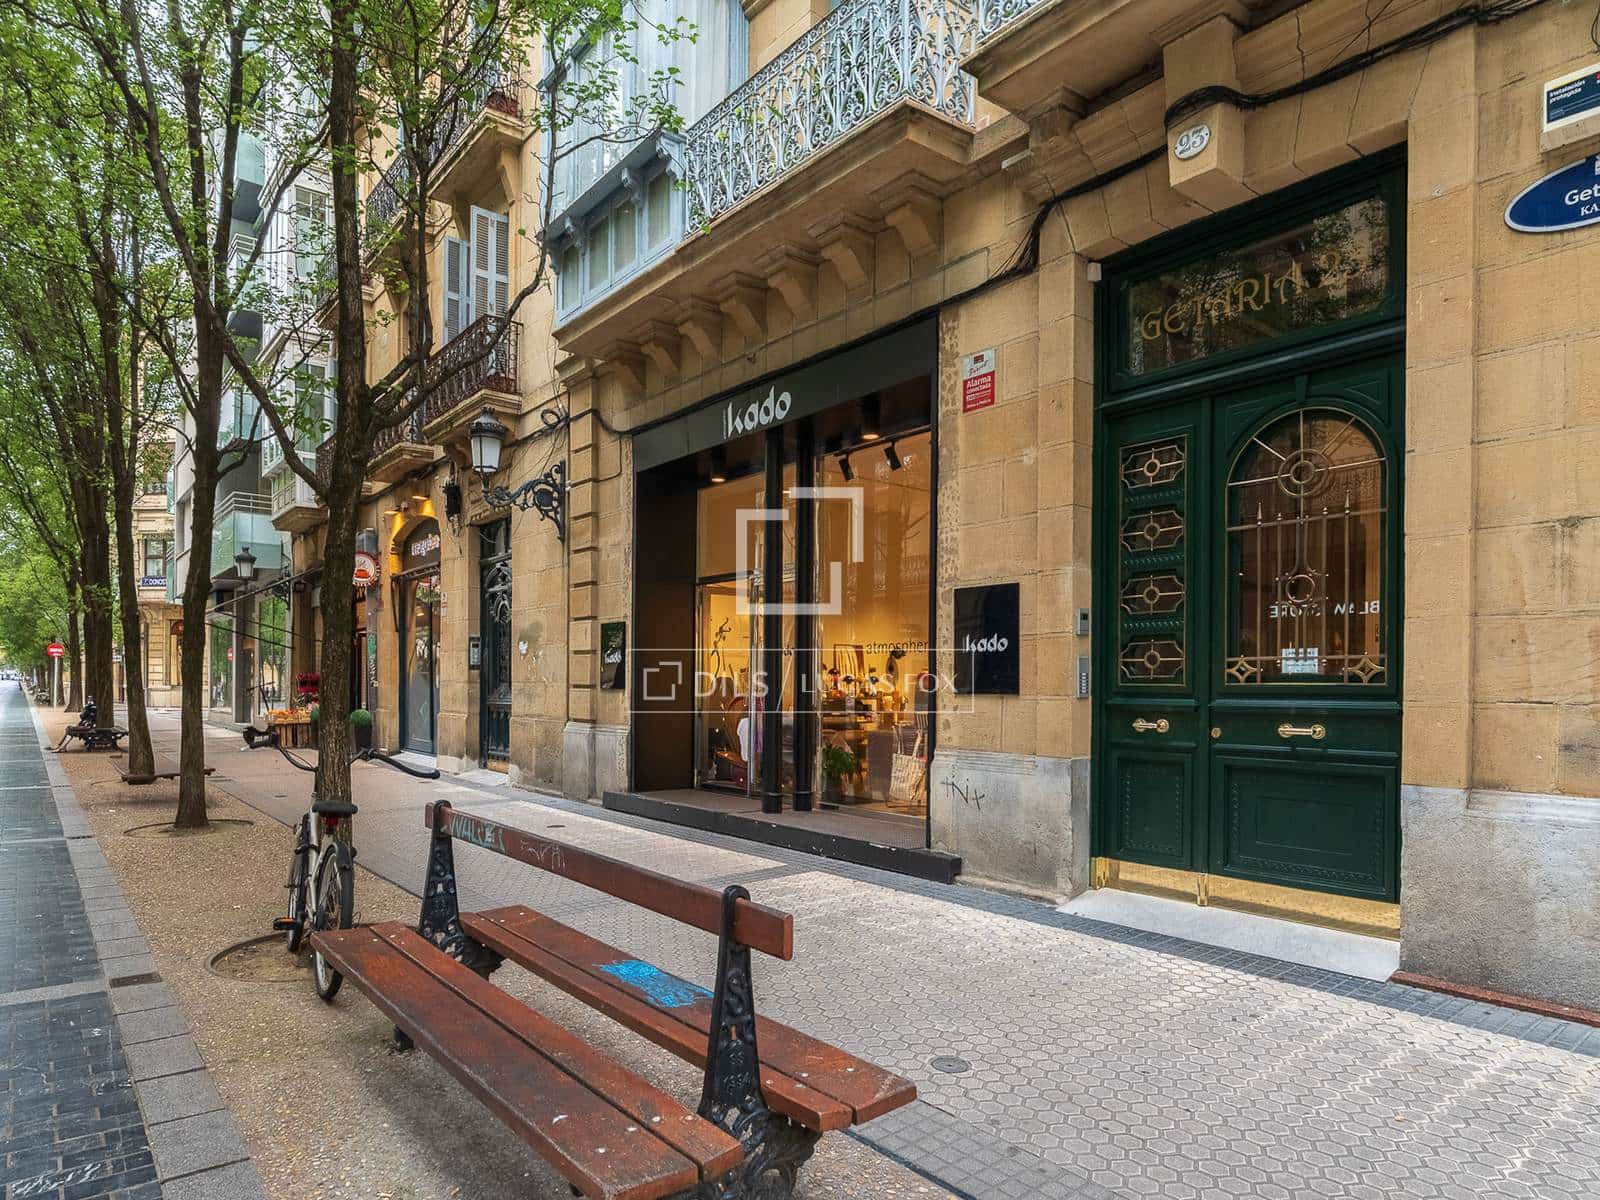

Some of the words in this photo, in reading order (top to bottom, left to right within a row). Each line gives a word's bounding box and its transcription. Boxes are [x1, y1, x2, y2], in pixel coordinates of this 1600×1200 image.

[1141, 261, 1309, 341] GETARIA
[966, 375, 992, 389] Alarma
[722, 385, 791, 439] kado
[962, 633, 1008, 653] kado
